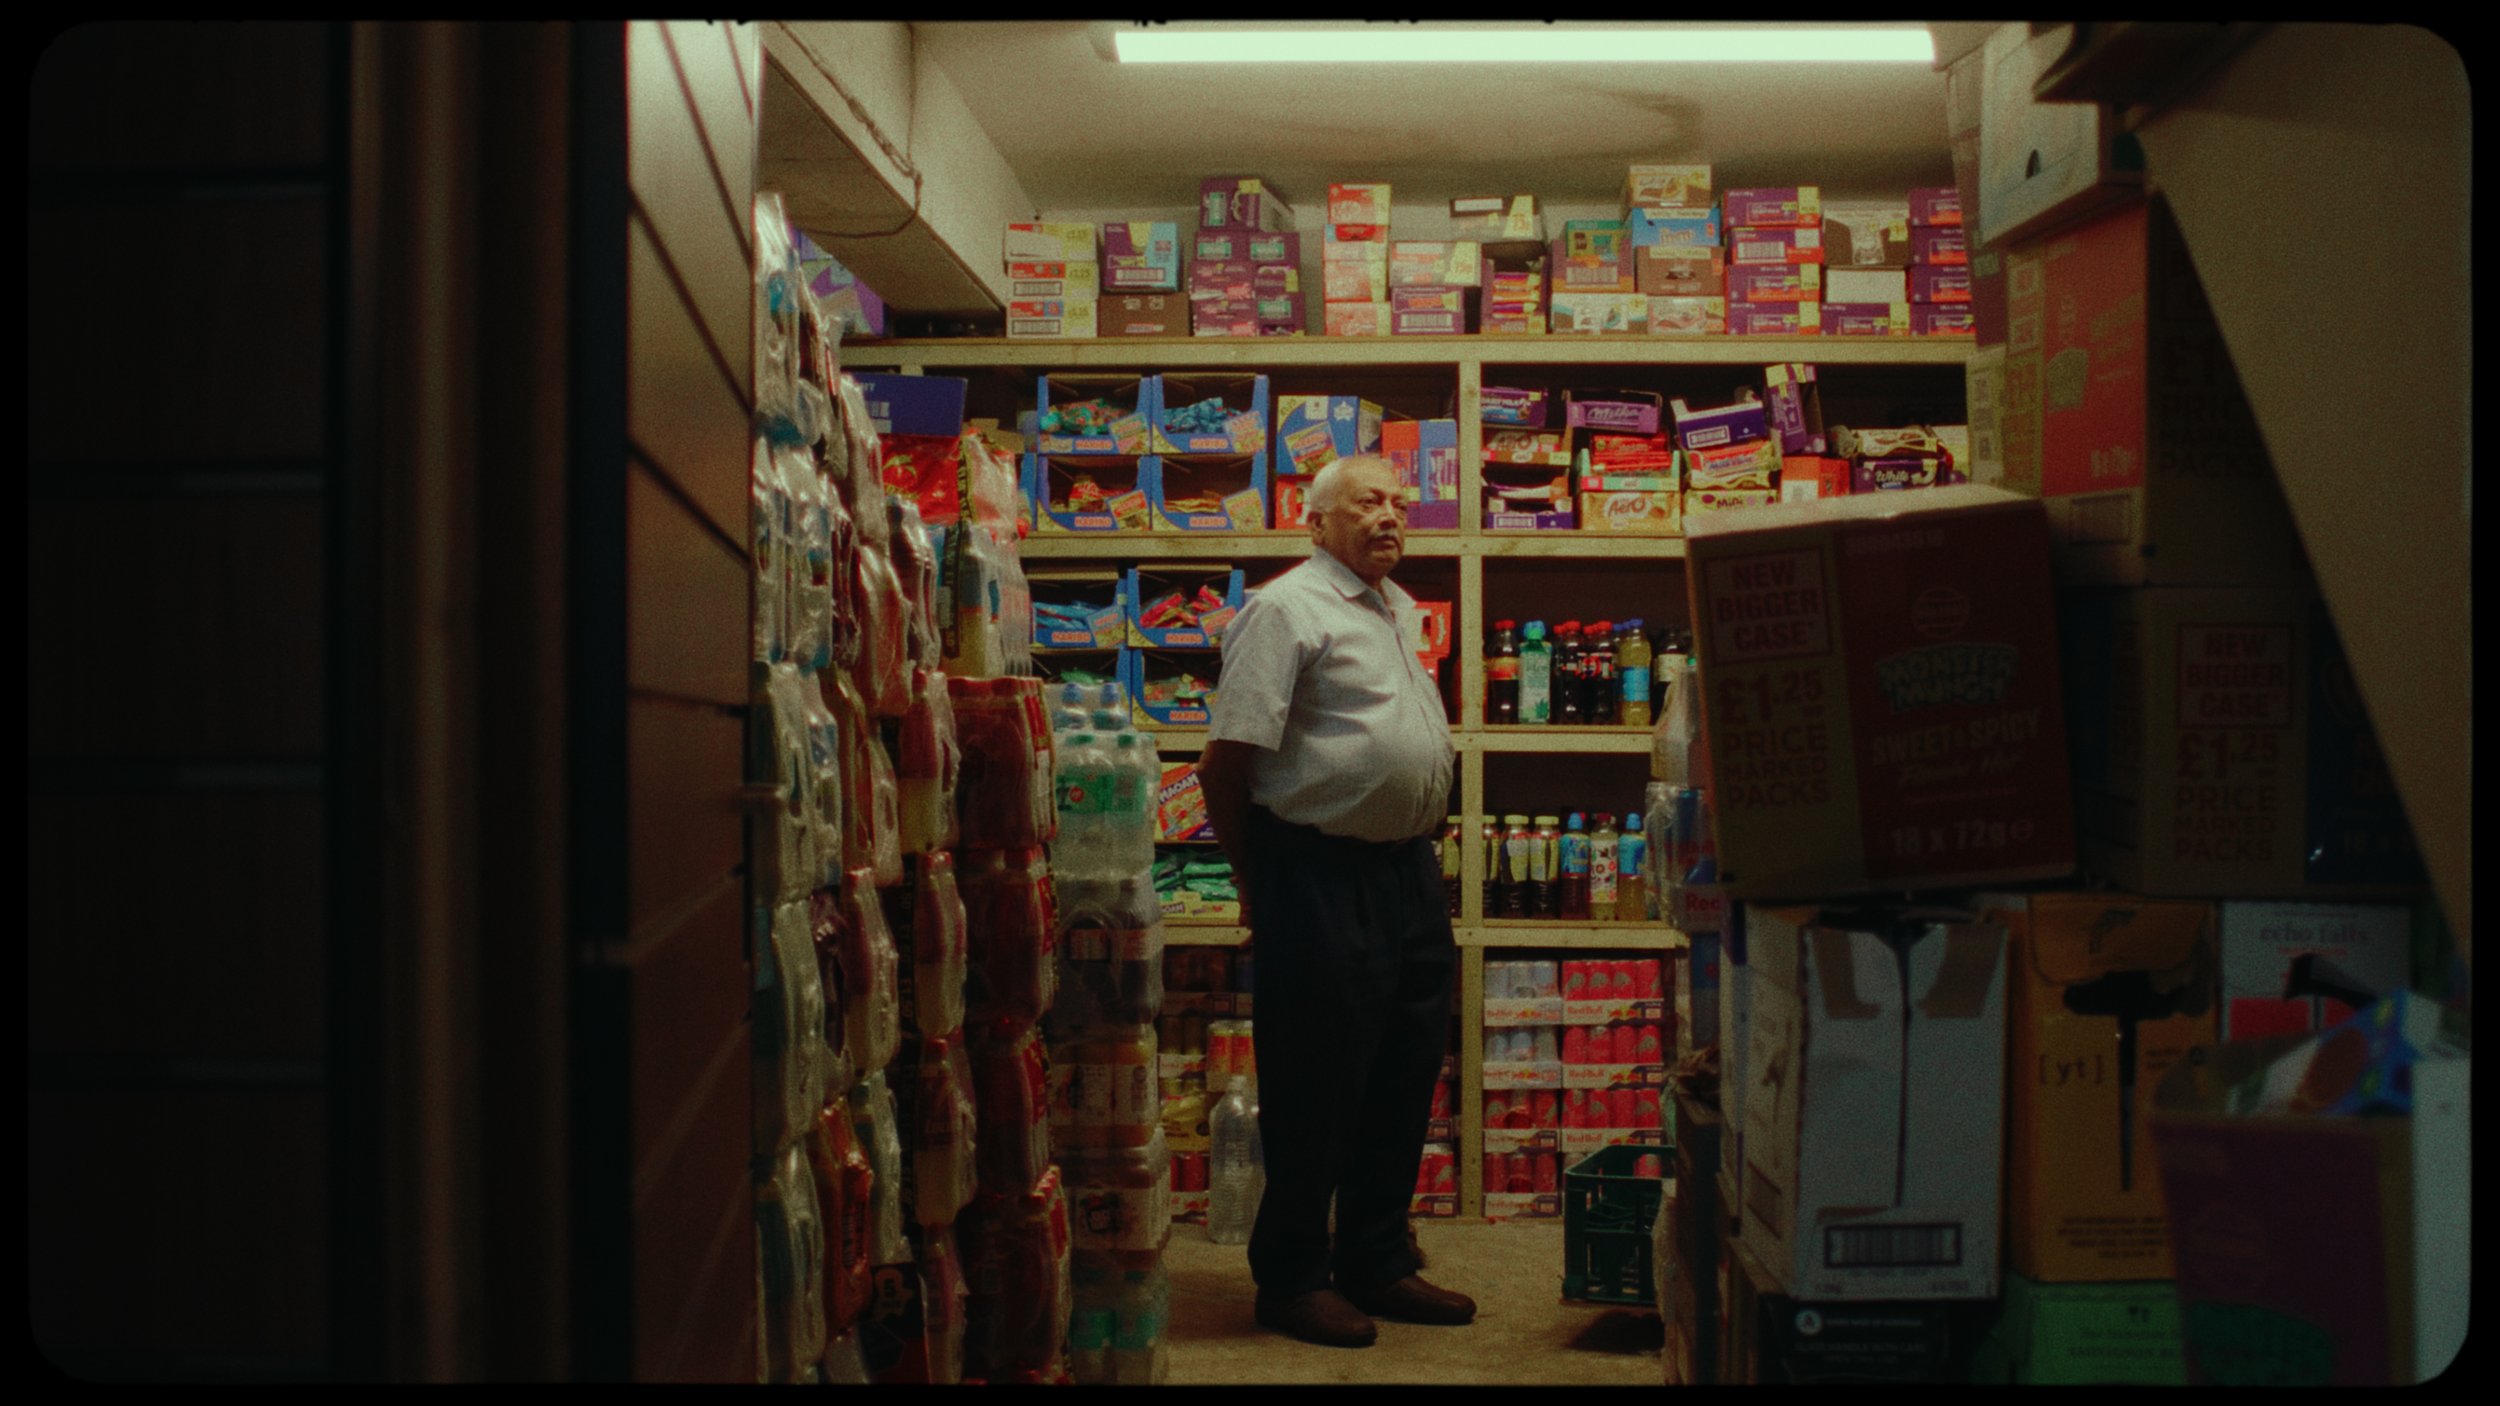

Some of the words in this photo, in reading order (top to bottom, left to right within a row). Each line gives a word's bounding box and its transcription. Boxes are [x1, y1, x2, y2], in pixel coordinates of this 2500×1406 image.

[1588, 404, 1640, 421] Milka
[1074, 439, 1114, 450] HARIBO
[1875, 468, 1909, 482] White
[1607, 497, 1647, 518] Aero
[1731, 559, 1796, 590] NEW
[1715, 589, 1820, 624] BIGGER
[1051, 631, 1092, 643] HARIBO
[1165, 633, 1204, 644] HARIBO
[2204, 632, 2267, 659] NEW
[2185, 663, 2284, 689] BIGGER
[1717, 668, 1824, 726] £1.25
[1169, 710, 1207, 721] HARIBO
[1721, 724, 1829, 760] PRICE
[1870, 724, 1953, 767] SWEET
[1968, 705, 2044, 750] SPICY
[1723, 754, 1828, 783] MARKED
[2176, 732, 2279, 780] £1.25
[1159, 771, 1200, 806] MAOAM
[1727, 778, 1832, 811] PACKS
[2175, 785, 2278, 813] PRICE
[2174, 814, 2277, 836] MARKED
[1890, 825, 1923, 857] 18
[2174, 837, 2274, 863] PACKS
[2259, 921, 2312, 944] echo
[2317, 920, 2369, 944] falls
